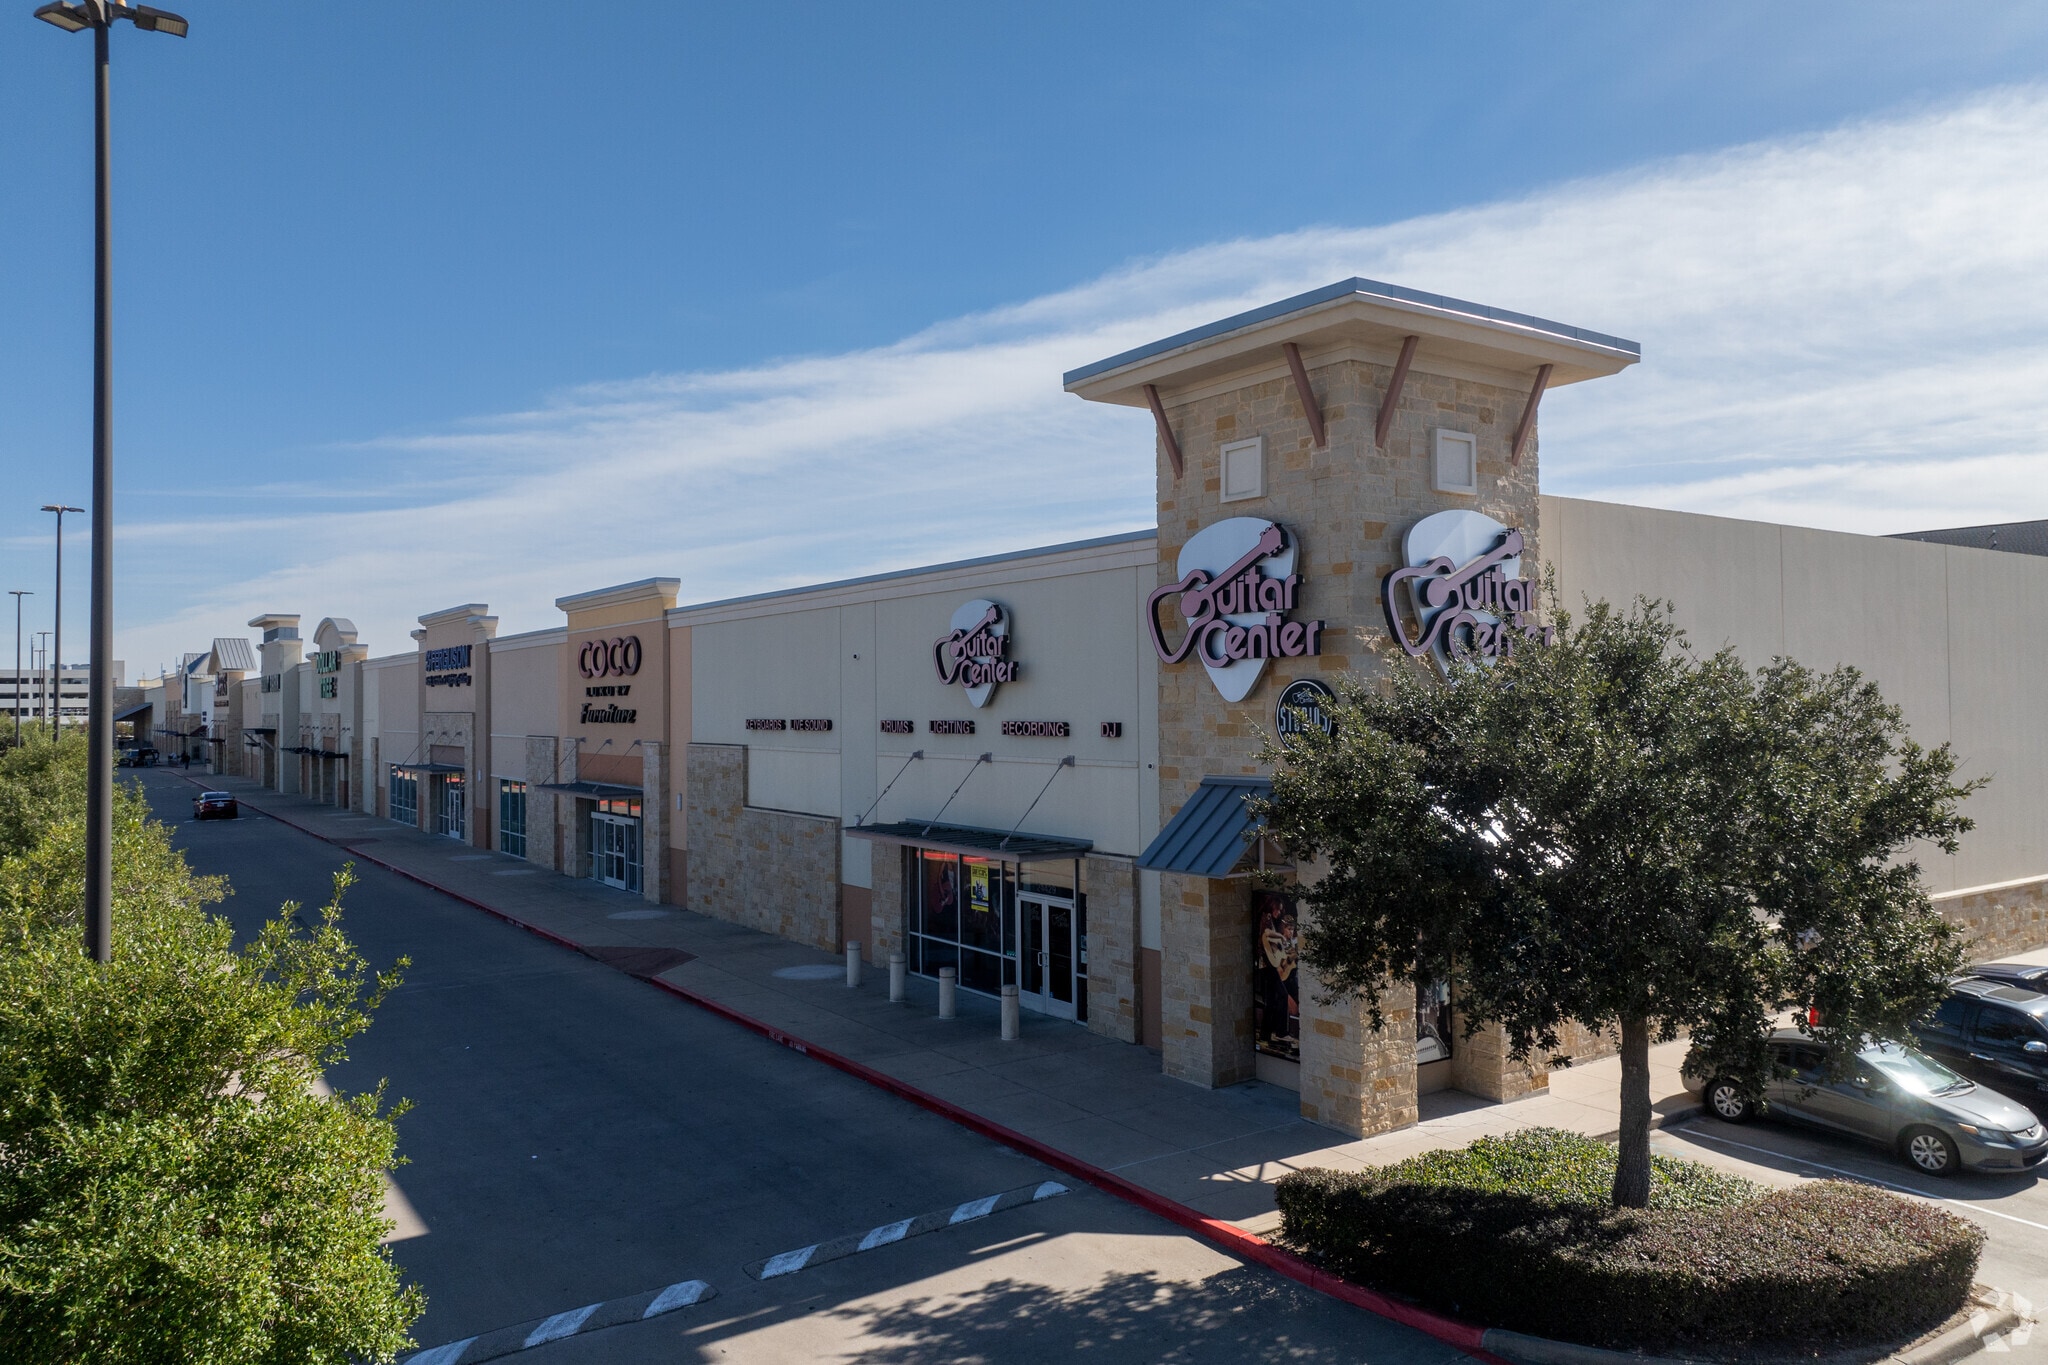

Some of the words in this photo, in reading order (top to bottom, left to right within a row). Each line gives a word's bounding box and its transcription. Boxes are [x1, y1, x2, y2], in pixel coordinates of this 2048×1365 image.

[1147, 558, 1303, 664] Guitar
[1381, 556, 1536, 656] Guitar
[1198, 614, 1324, 667] Center
[431, 645, 471, 670] FERGUSON
[578, 636, 642, 679] COCO
[933, 629, 1006, 685] Guitar
[959, 657, 1017, 688] Center
[586, 685, 631, 697] LUXURY
[581, 702, 637, 724] Furniture
[746, 719, 784, 730] KEYBOARDS
[791, 719, 804, 730] LIVE
[804, 719, 830, 731] SOUND
[880, 720, 911, 733] DRUMS
[929, 720, 973, 734] LIGHTING
[1002, 721, 1067, 737] RECORDING
[1101, 722, 1119, 737] DJ
